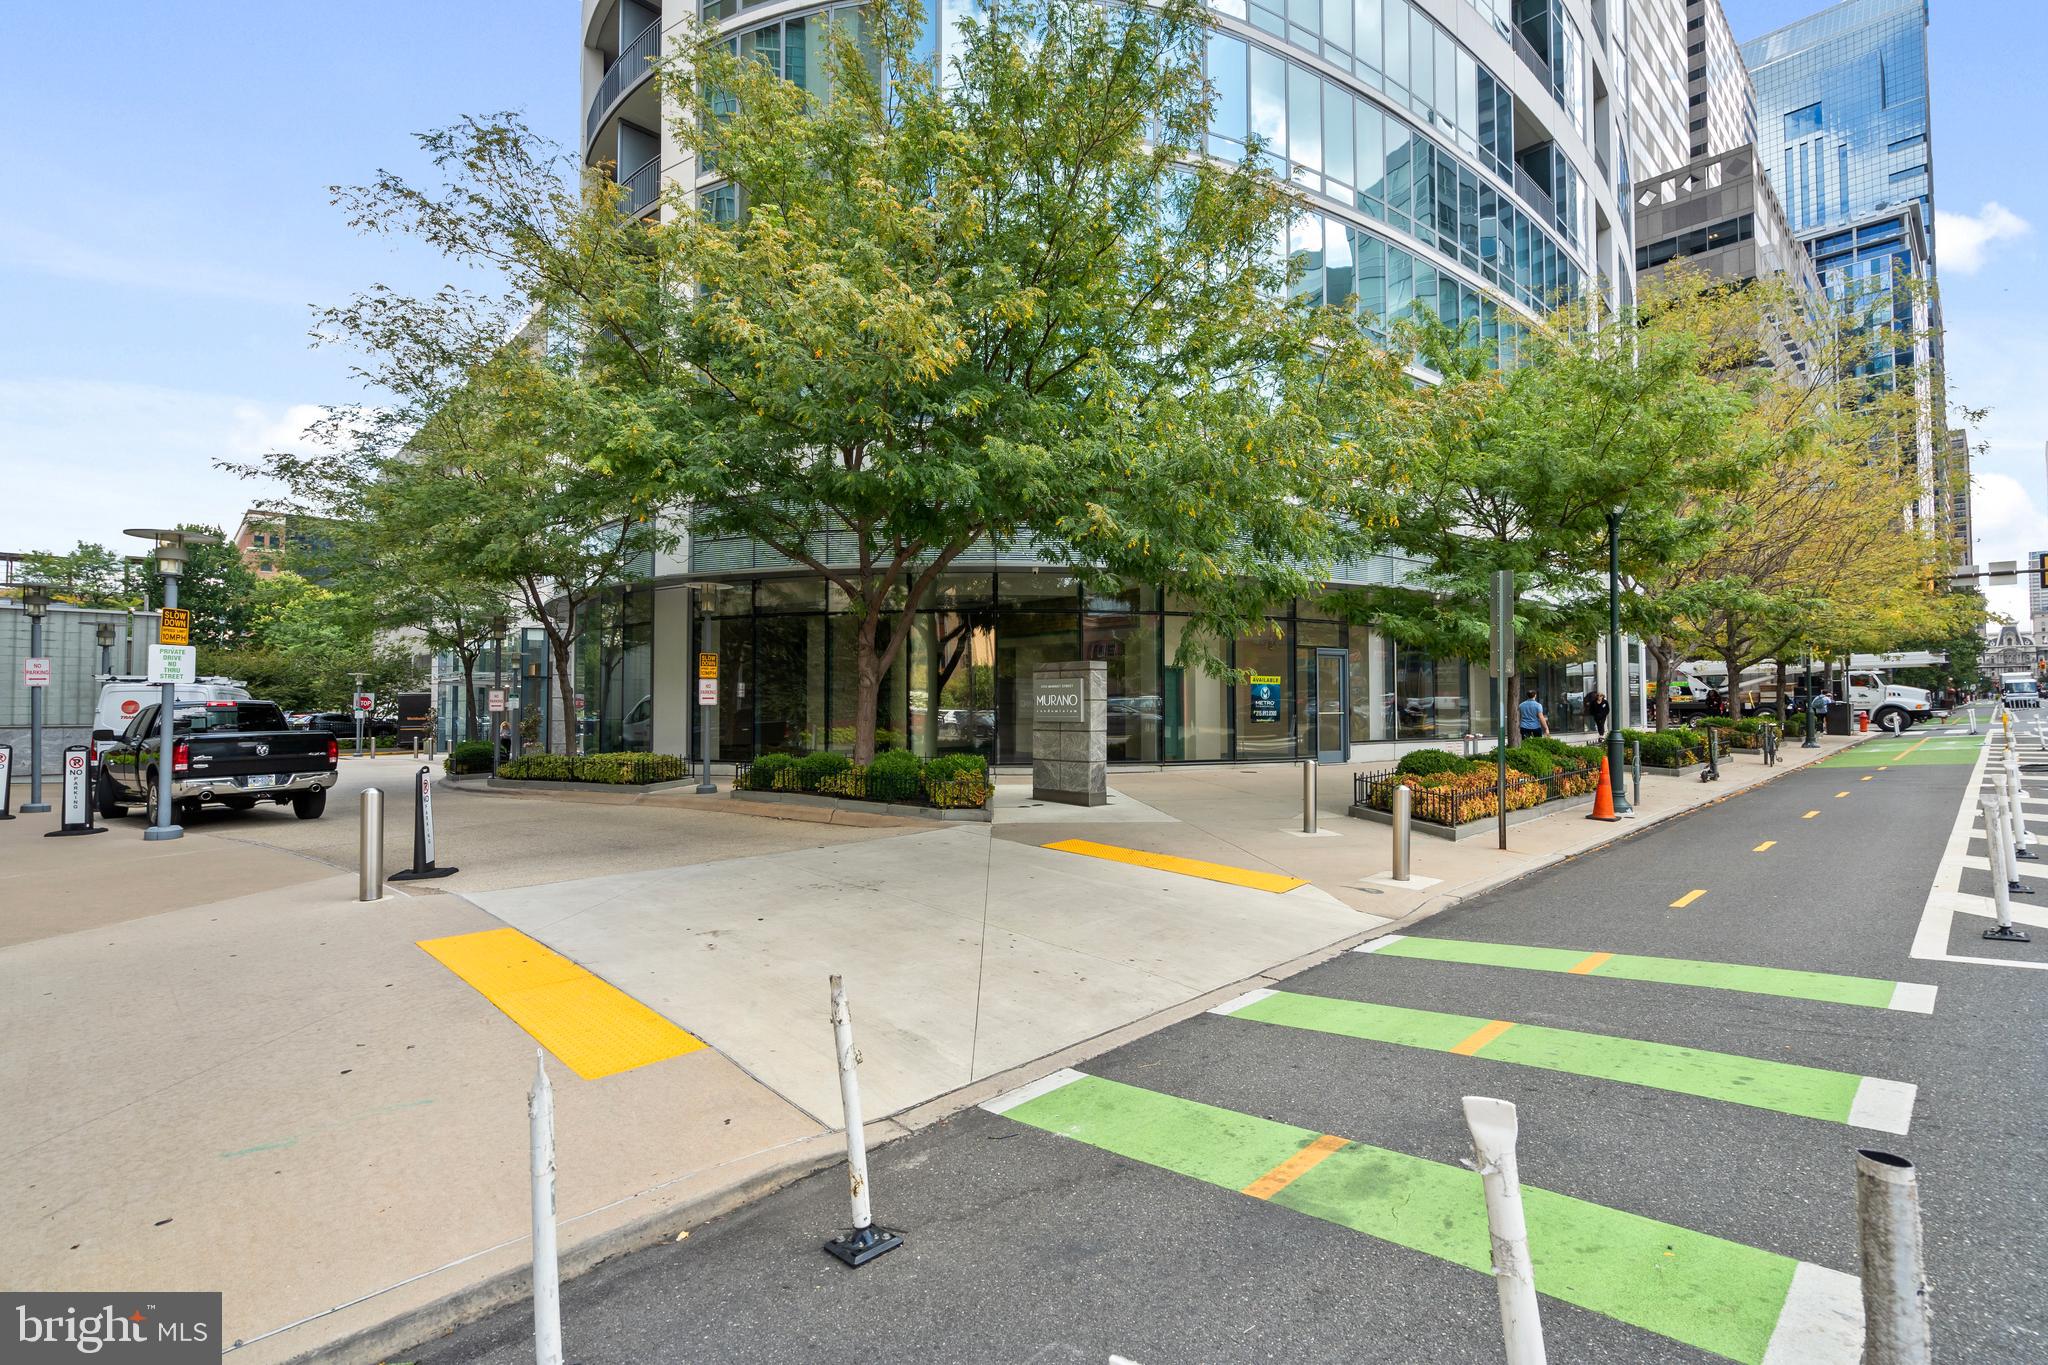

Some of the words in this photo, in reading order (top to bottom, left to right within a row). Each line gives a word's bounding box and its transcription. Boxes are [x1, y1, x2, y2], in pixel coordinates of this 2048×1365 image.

[165, 611, 186, 620] SLOW
[164, 619, 186, 628] DOWN
[162, 633, 186, 642] 10MPH
[1036, 694, 1078, 706] MURANO
